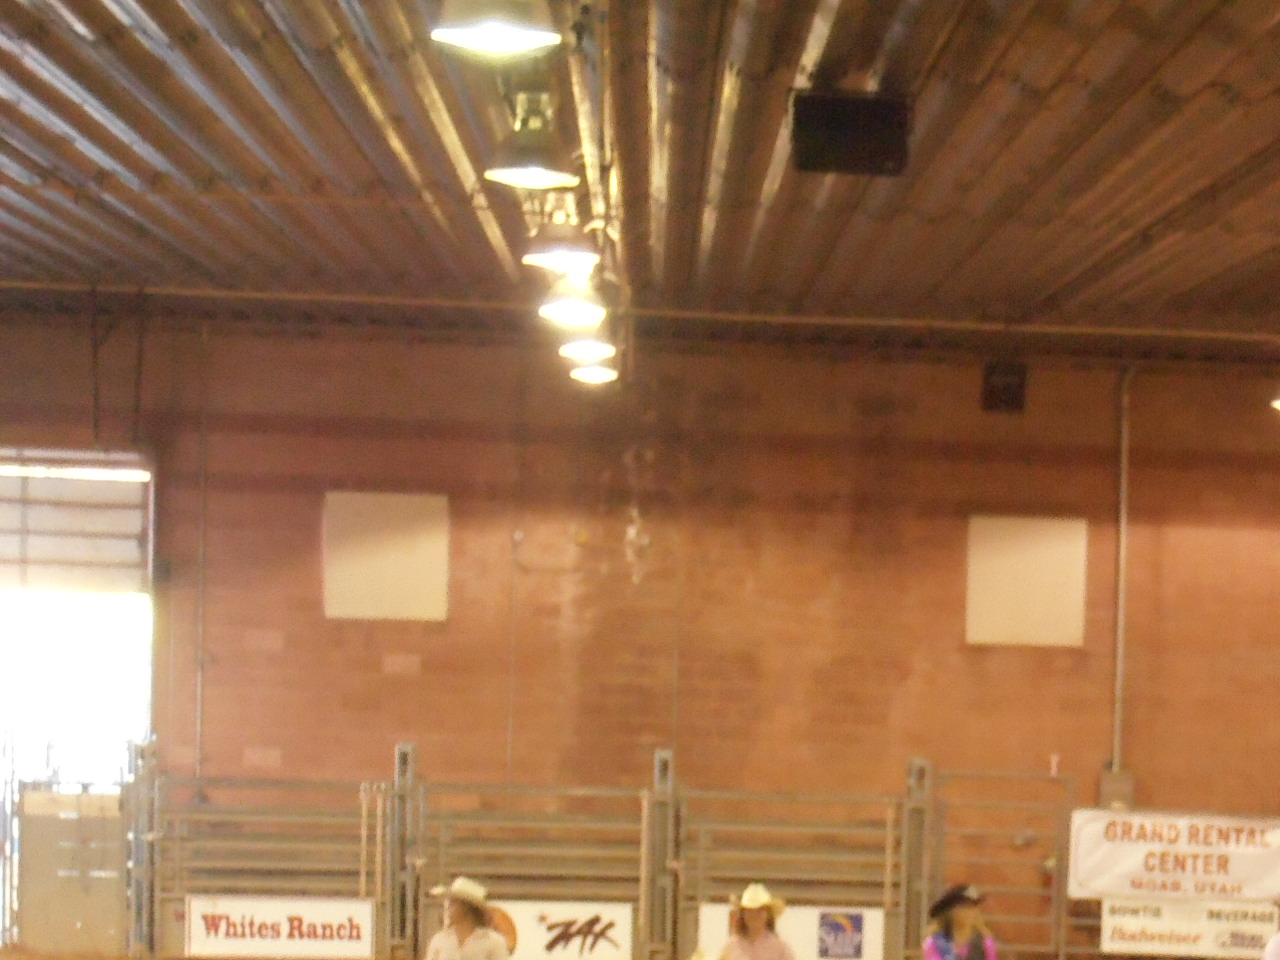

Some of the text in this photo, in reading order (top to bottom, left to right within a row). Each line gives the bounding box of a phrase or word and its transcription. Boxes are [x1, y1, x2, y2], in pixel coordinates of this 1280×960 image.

[1104, 819, 1272, 848] GRAND RENTAL
[1143, 850, 1231, 875] CENTER
[202, 913, 362, 940] Whites Ranch
